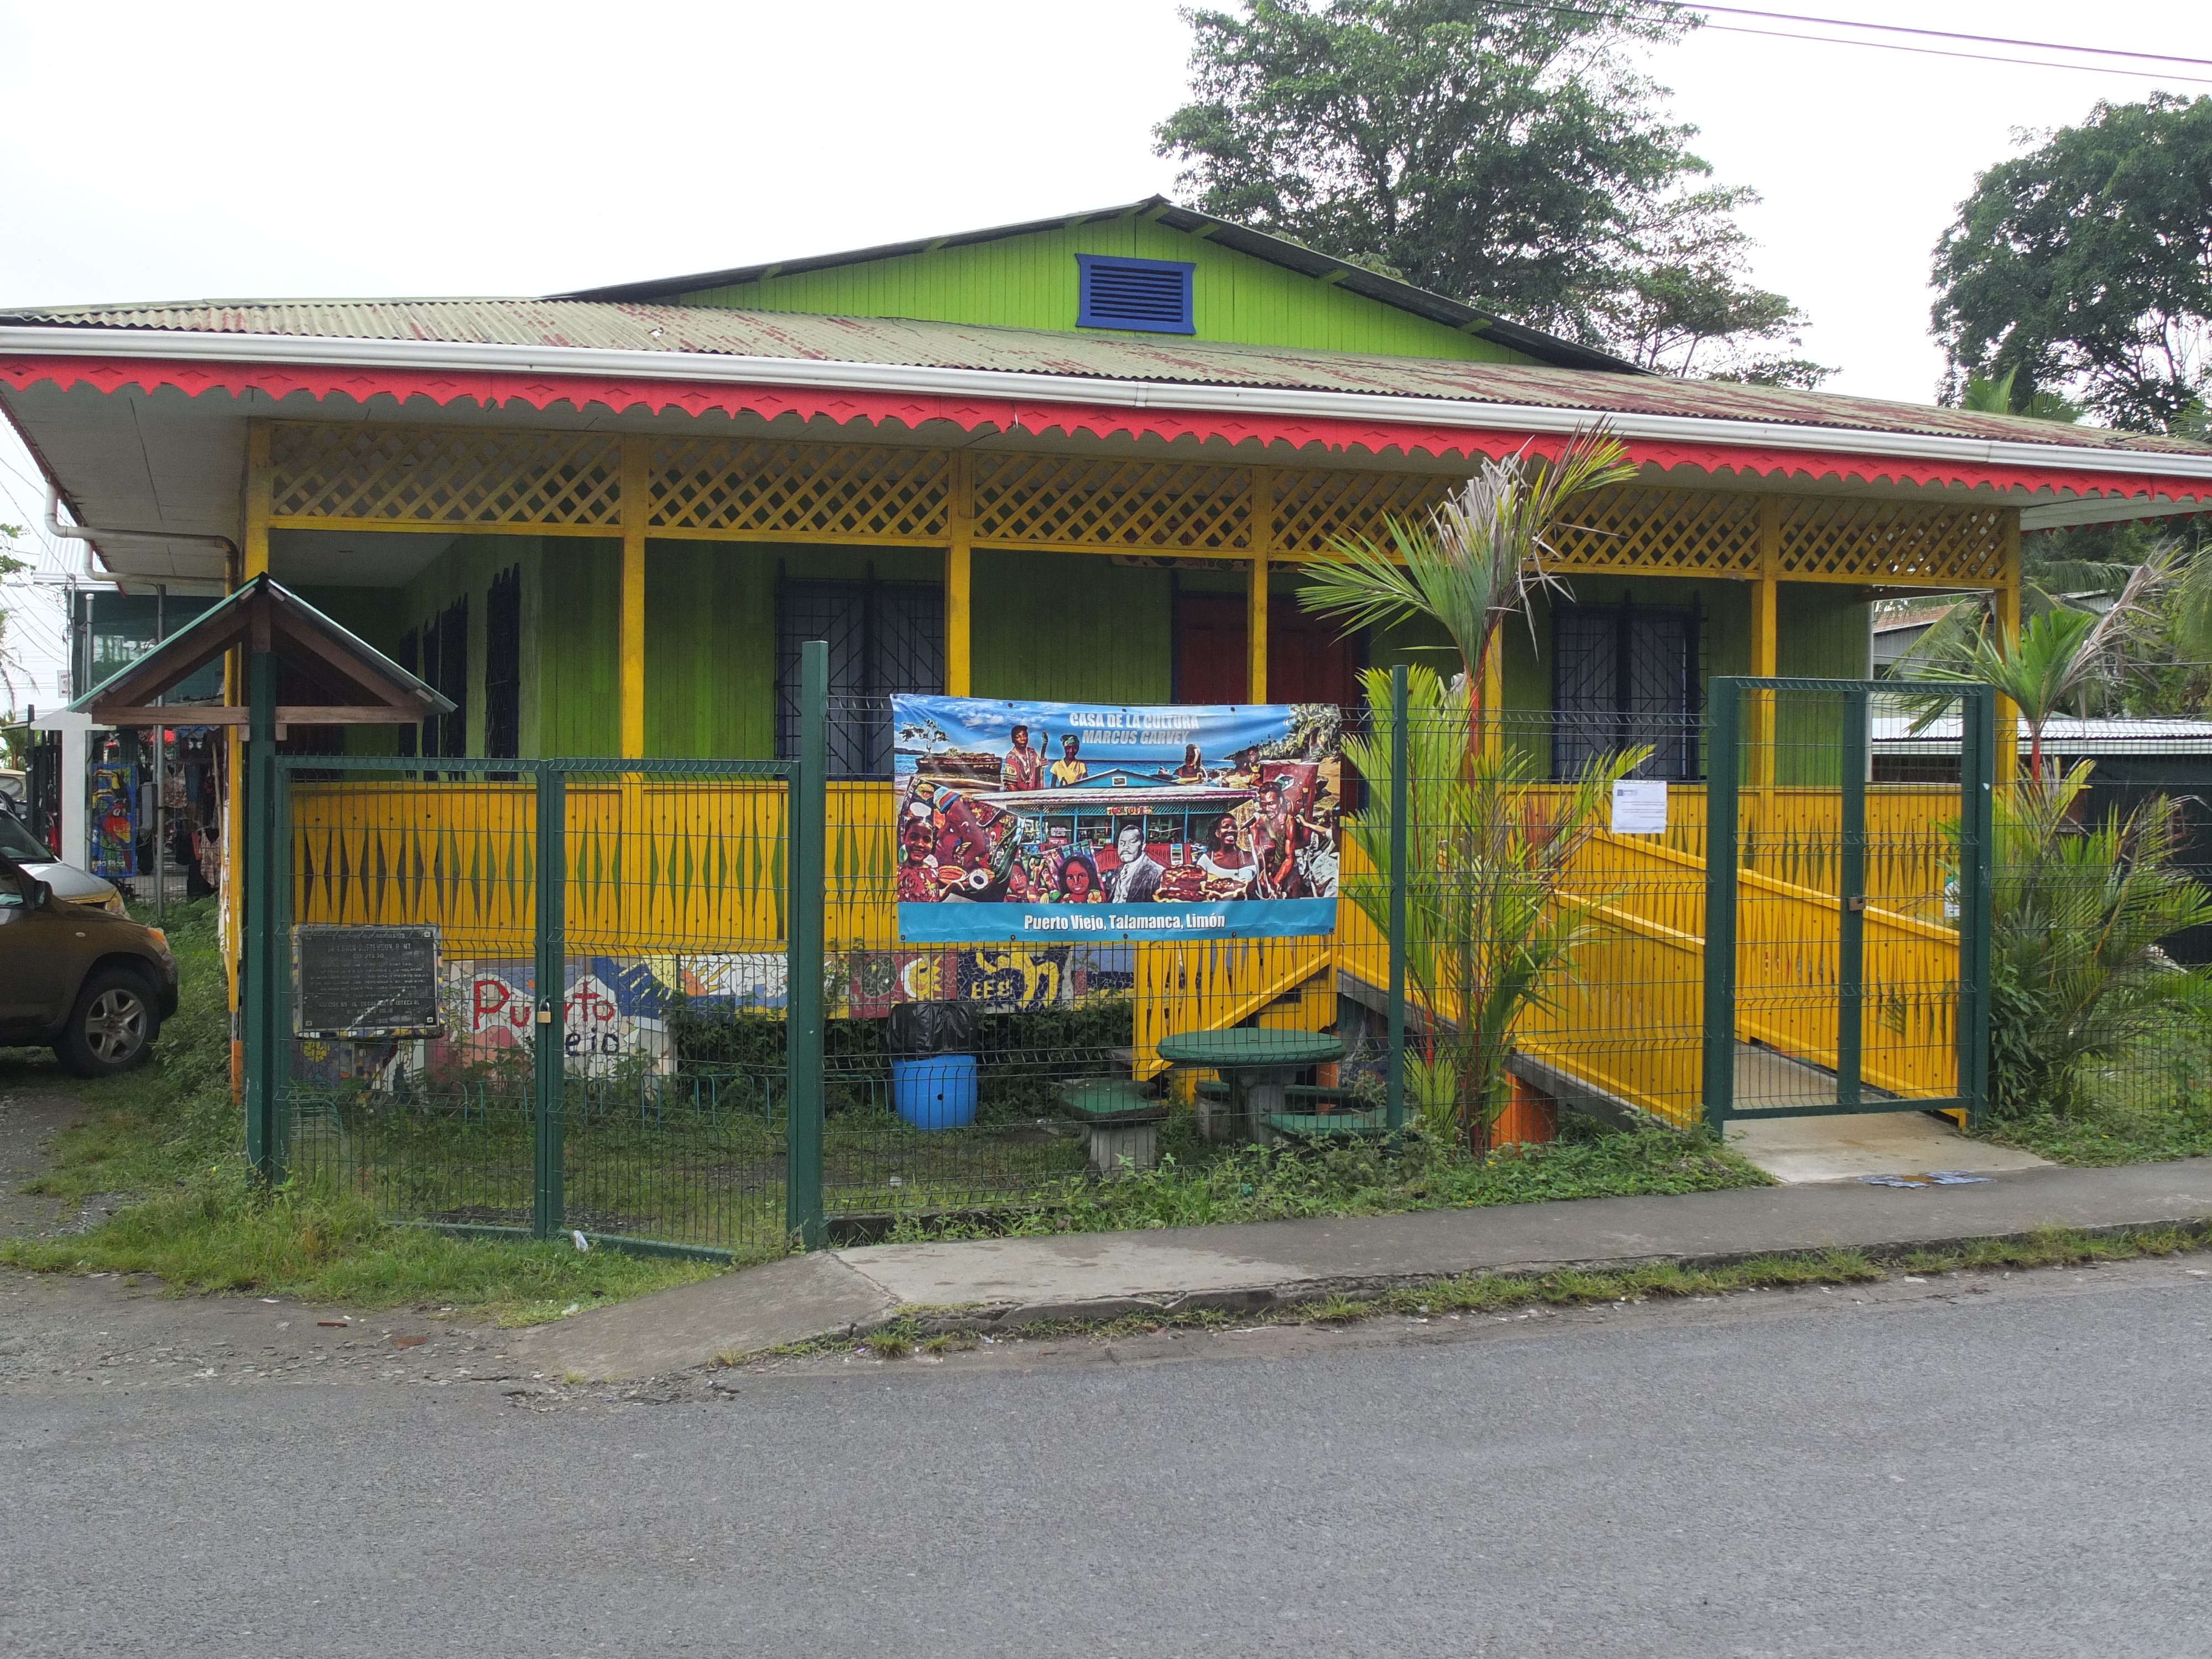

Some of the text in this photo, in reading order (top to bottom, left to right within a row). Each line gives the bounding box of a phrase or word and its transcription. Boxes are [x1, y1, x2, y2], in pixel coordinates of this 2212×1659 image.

[1070, 713, 1200, 729] CASA DE LA CULTURA
[1082, 730, 1189, 744] MARCUS GARVEY
[1024, 913, 1225, 931] Puerto Viejo, Talamanca, Limón
[474, 980, 614, 1030] Purto
